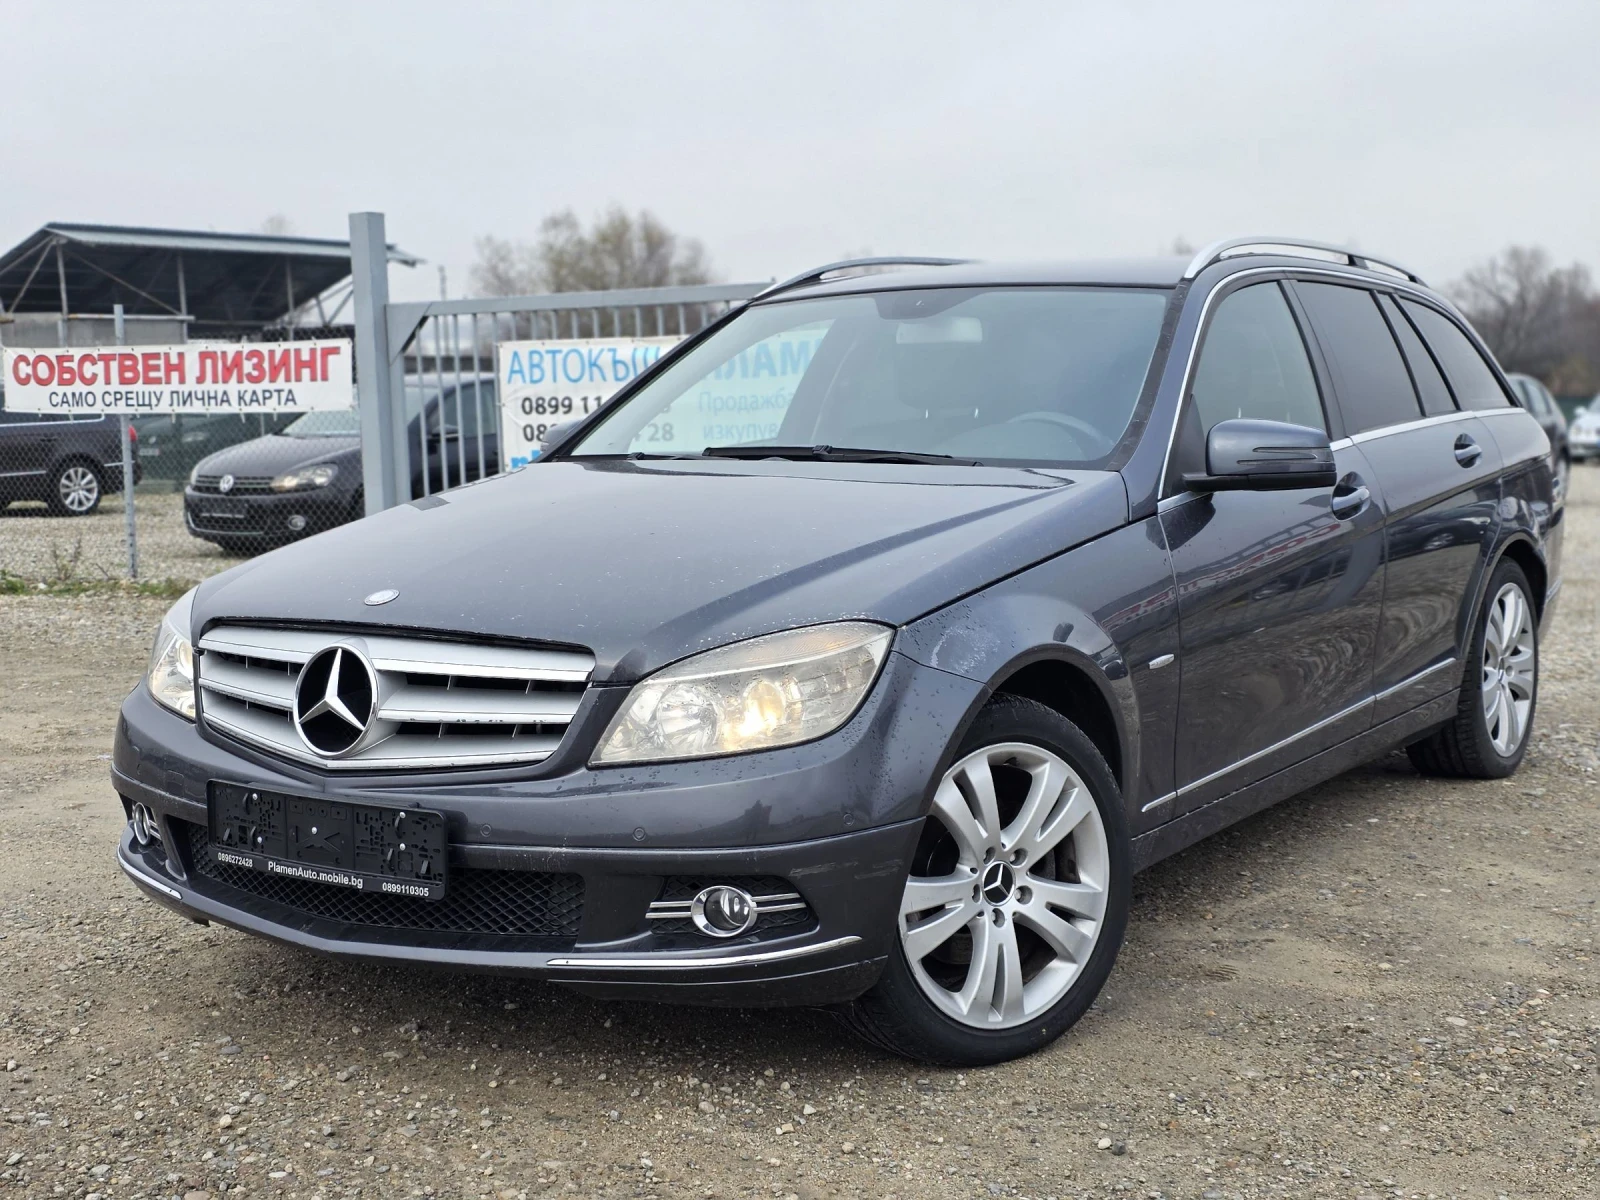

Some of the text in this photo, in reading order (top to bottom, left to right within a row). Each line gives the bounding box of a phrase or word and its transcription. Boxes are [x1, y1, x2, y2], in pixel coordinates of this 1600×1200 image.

[12, 346, 341, 386] СОБСТВЕН ЛИЗИНГ
[714, 339, 823, 380] ЛАМ
[49, 389, 297, 410] САМО СРЕЩУ ЛИЧНА КАРТА
[521, 396, 573, 415] 0899
[647, 422, 674, 442] 28
[217, 852, 253, 868] 0896272428
[268, 861, 363, 888] PlamenAuto.mobile.bg
[382, 882, 429, 897] 0899110305
